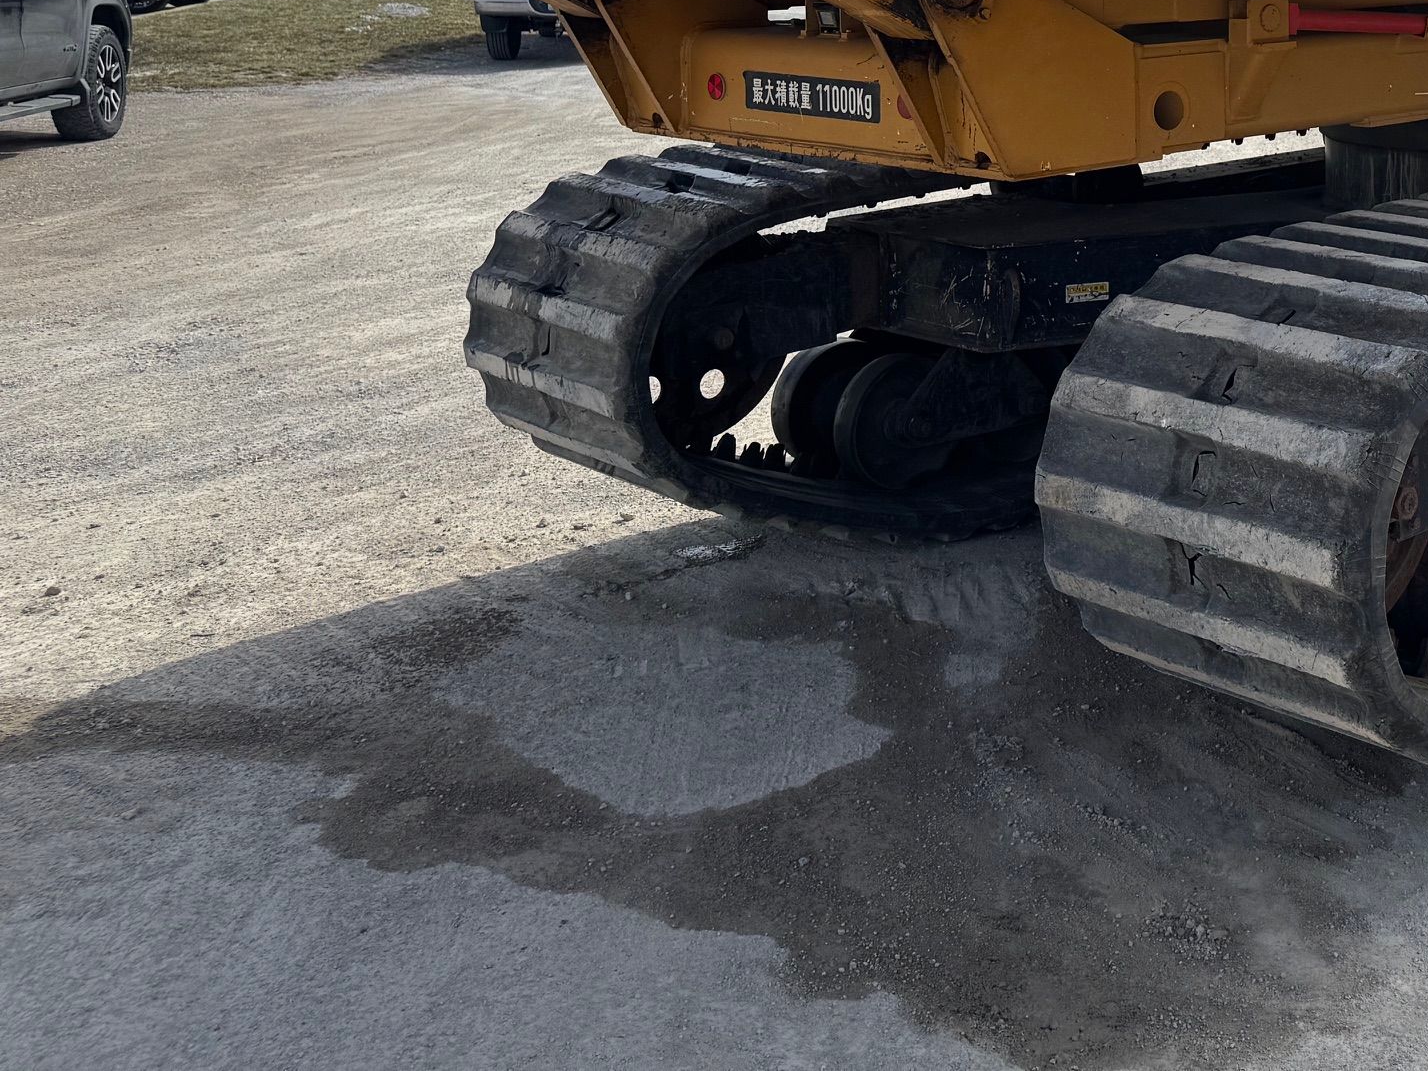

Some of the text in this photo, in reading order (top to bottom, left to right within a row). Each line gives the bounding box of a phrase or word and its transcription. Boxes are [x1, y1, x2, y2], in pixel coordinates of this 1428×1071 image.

[752, 78, 813, 110] 最大積載量
